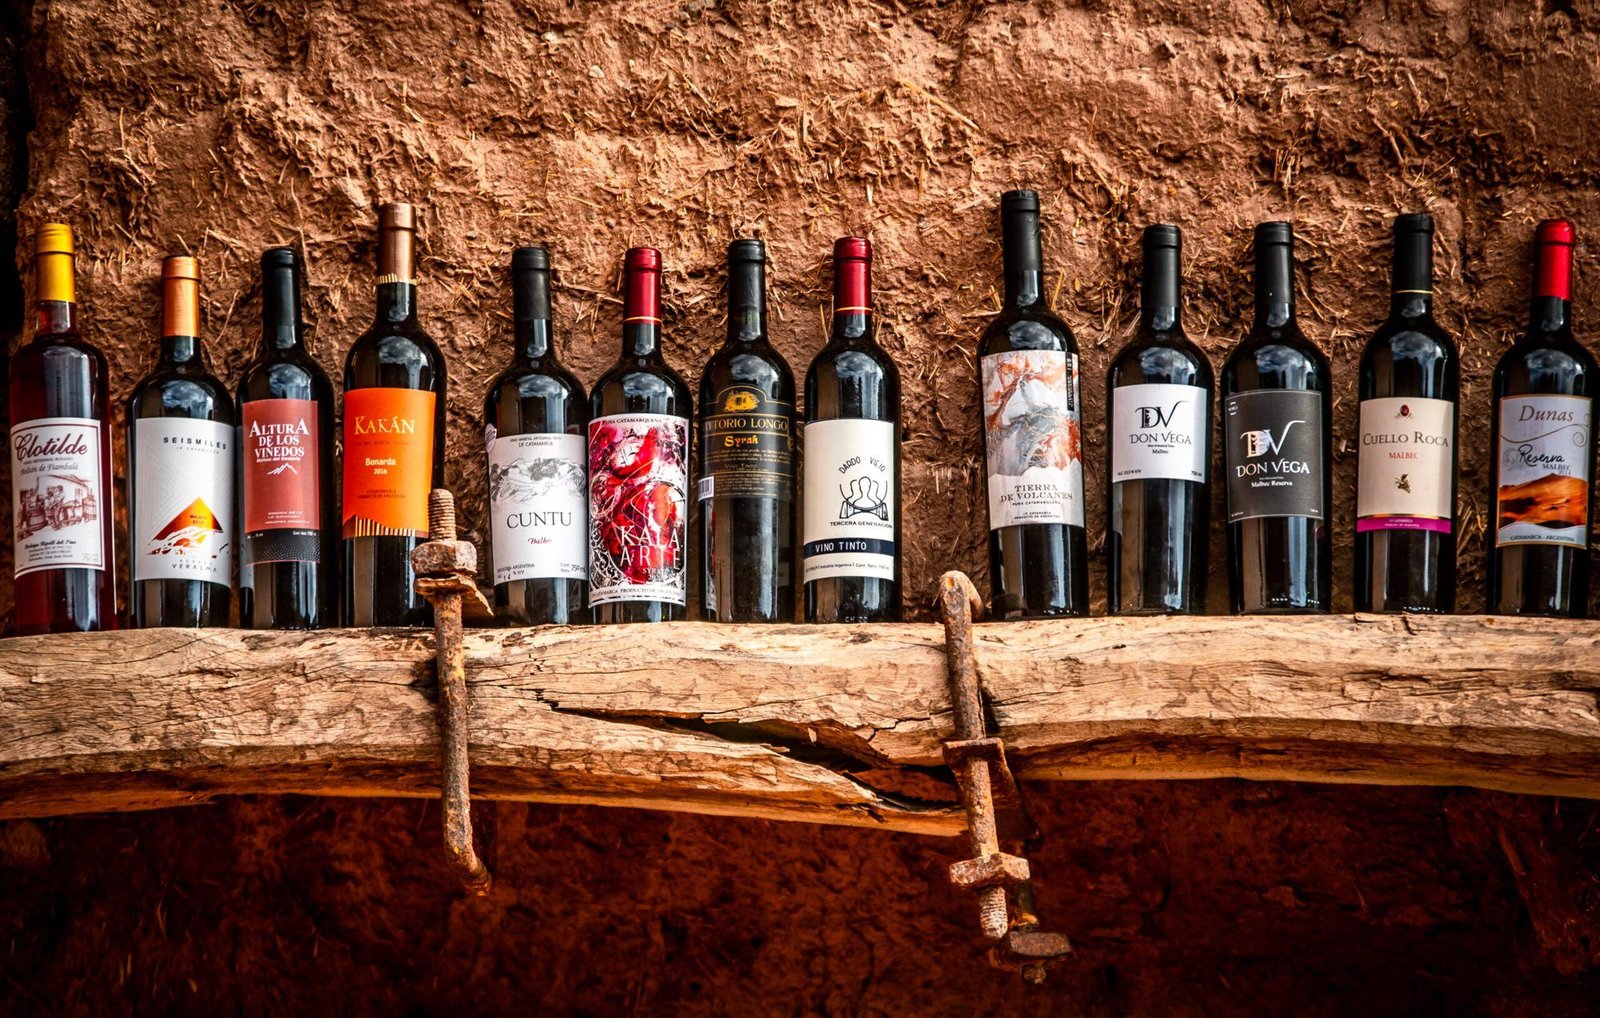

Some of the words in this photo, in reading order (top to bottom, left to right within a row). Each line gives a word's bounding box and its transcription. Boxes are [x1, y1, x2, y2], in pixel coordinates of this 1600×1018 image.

[1135, 400, 1190, 429] DV
[1518, 405, 1574, 422] Dunas
[249, 418, 310, 437] ALTURA
[354, 416, 416, 435] KAKÁN
[704, 418, 747, 431] ITTORIO
[750, 418, 788, 431] LONGO
[163, 437, 227, 450] SEISMILES
[259, 434, 273, 448] DE
[276, 433, 300, 446] LOS
[724, 435, 758, 447] Syrah
[1129, 433, 1158, 445] DON
[1161, 431, 1192, 445] VEGA
[1240, 420, 1306, 458] DV
[1363, 433, 1409, 446] CUELLO
[1414, 431, 1450, 447] ROCA
[15, 433, 87, 462] Clotilde
[255, 444, 304, 459] VIÑEDOS
[1518, 444, 1566, 467] Reserva
[365, 457, 396, 466] Bonarda
[838, 456, 862, 474] DARDO
[1236, 462, 1268, 478] DON
[1271, 458, 1310, 474] VEGA
[1014, 484, 1058, 492] TIERRA
[1000, 494, 1014, 503] DE
[1017, 492, 1072, 501] VOLCANES
[506, 511, 572, 529] CUNTU
[858, 521, 893, 530] GENERACIÓN
[620, 525, 683, 551] KALA
[815, 543, 834, 553] VINO
[839, 541, 867, 551] TINTO
[620, 546, 682, 571] ARTE
[172, 563, 217, 573] VERALMA
